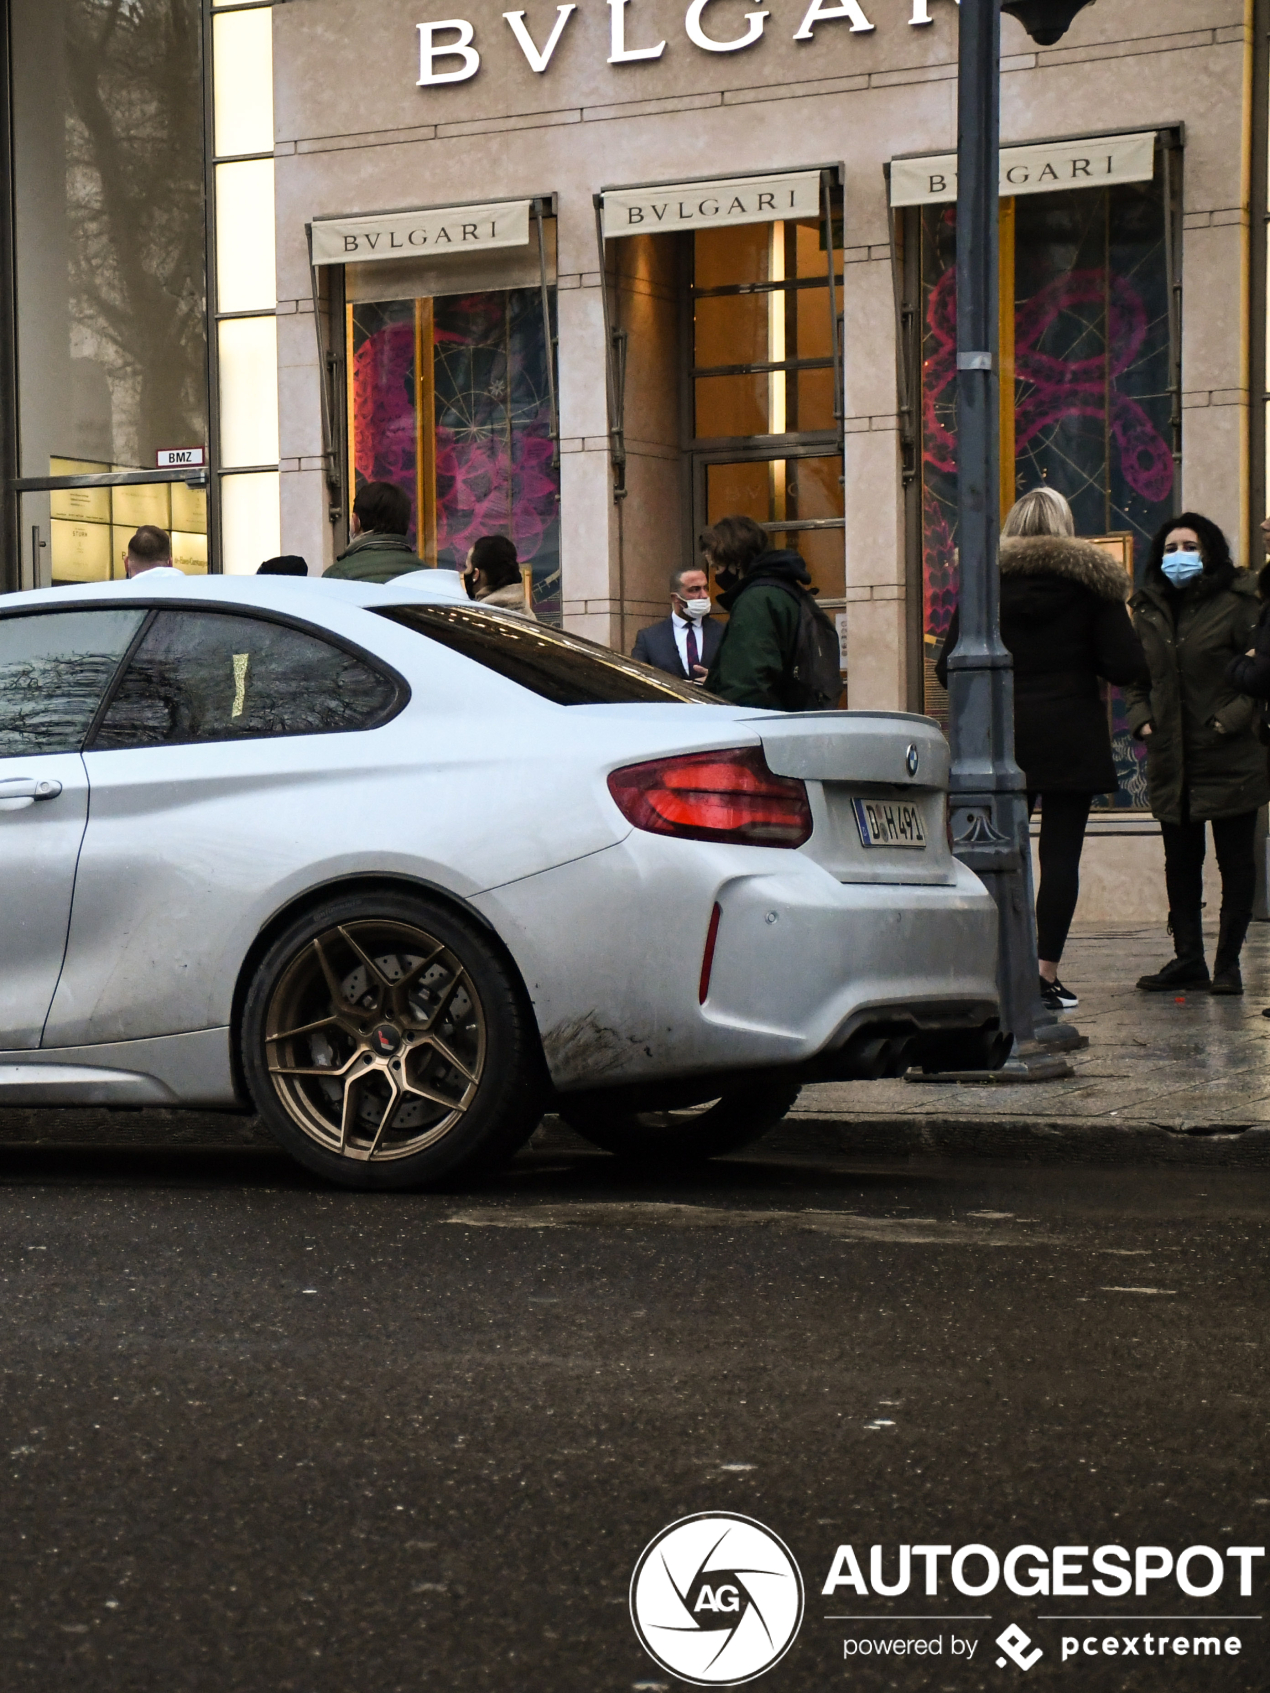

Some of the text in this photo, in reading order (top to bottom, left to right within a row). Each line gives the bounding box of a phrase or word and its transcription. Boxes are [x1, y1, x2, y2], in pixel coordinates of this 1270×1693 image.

[415, 0, 960, 86] BVLGA
[928, 155, 1113, 194] BGARI
[628, 189, 796, 226] BVLGARI
[343, 220, 497, 253] BVLGARI
[168, 451, 192, 463] BMZ
